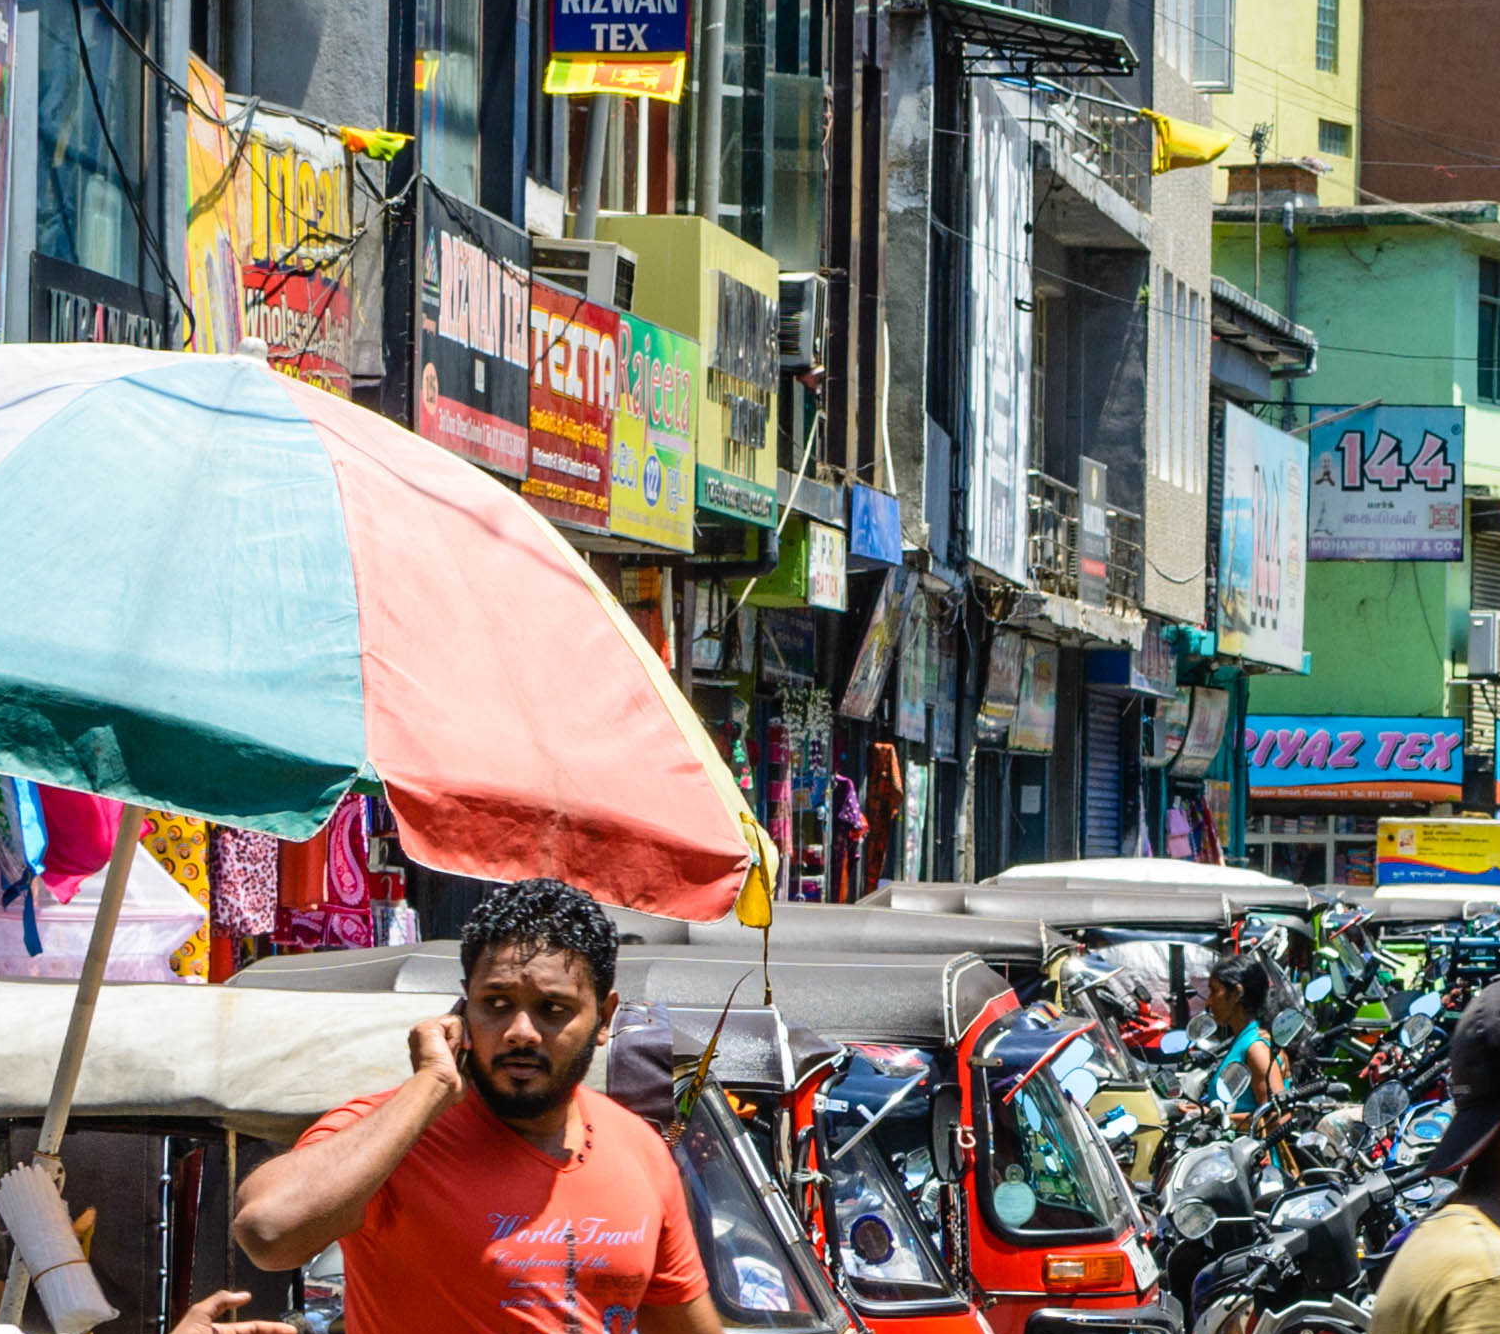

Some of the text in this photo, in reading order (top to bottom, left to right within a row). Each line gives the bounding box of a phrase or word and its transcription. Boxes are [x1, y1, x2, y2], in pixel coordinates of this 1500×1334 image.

[590, 22, 649, 52] TEX
[529, 303, 619, 411] TEXTA
[616, 319, 692, 455] Rajeeta
[1335, 428, 1456, 493] 144
[1420, 540, 1431, 553] &
[1374, 731, 1460, 771] TEX
[486, 1212, 573, 1245] World
